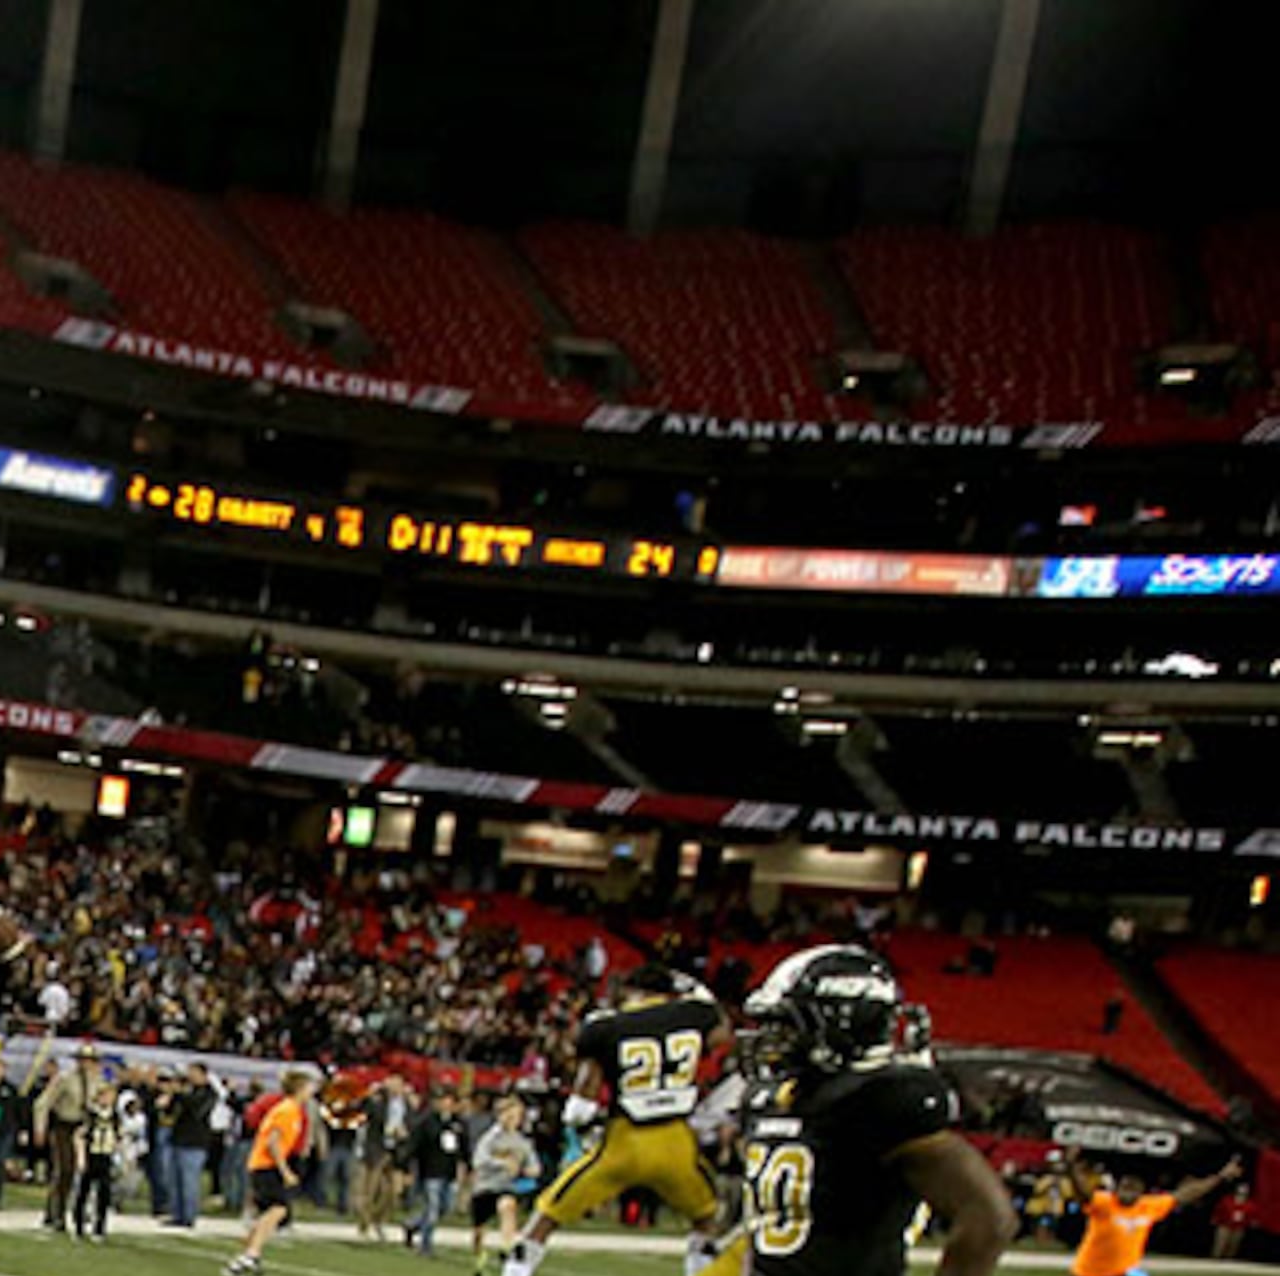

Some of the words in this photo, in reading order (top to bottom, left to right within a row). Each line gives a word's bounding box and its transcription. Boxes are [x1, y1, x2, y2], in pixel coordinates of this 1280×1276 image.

[114, 331, 253, 377] ATLANTA
[260, 362, 410, 403] FALCONS
[662, 412, 823, 442] ATLANTA
[835, 421, 1013, 447] FALCONS
[628, 541, 674, 576] 24
[808, 810, 999, 840] ATLANTA
[1015, 821, 1226, 851] FALCONS
[1052, 1120, 1178, 1157] GEICO
